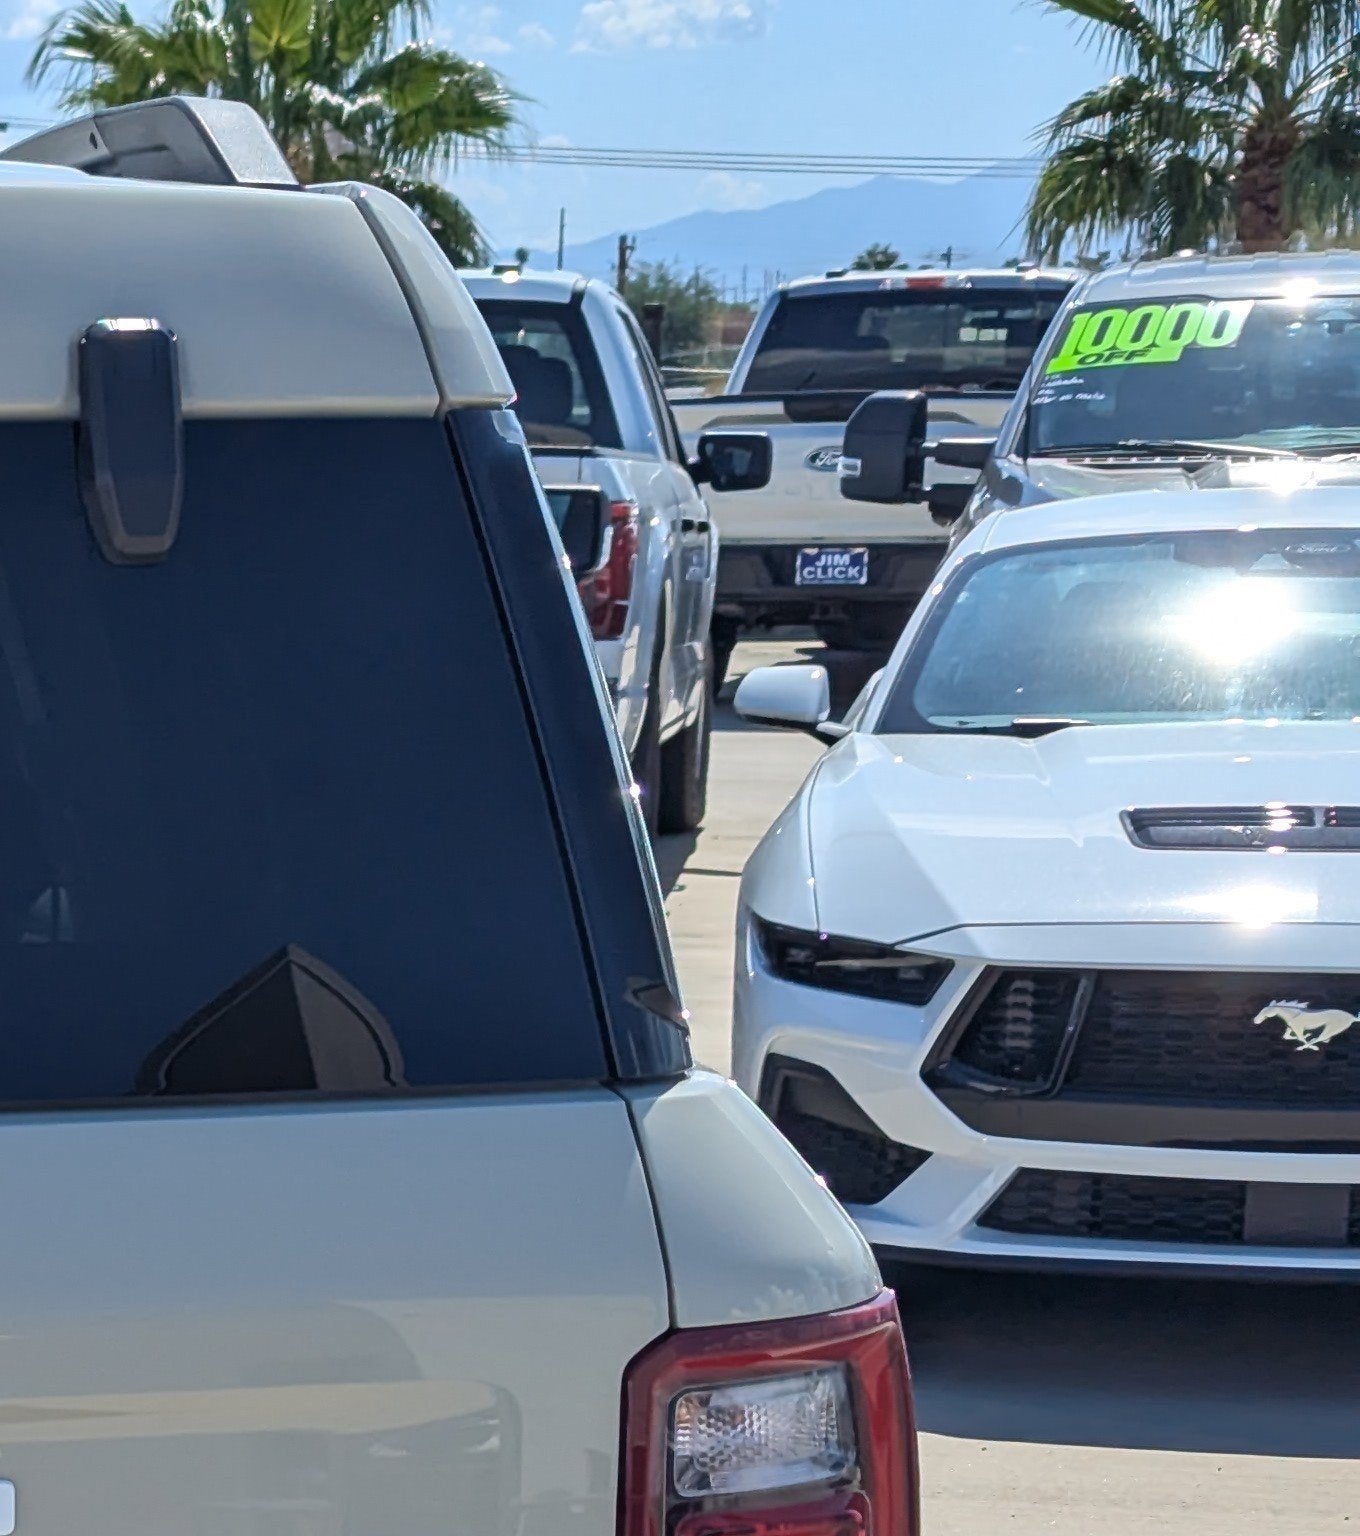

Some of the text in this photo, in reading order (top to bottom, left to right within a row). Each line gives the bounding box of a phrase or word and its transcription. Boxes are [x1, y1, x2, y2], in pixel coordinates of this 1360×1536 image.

[1058, 301, 1252, 357] 10000
[1077, 350, 1150, 365] OFF
[815, 553, 850, 567] JIM
[802, 567, 861, 579] CLICK
